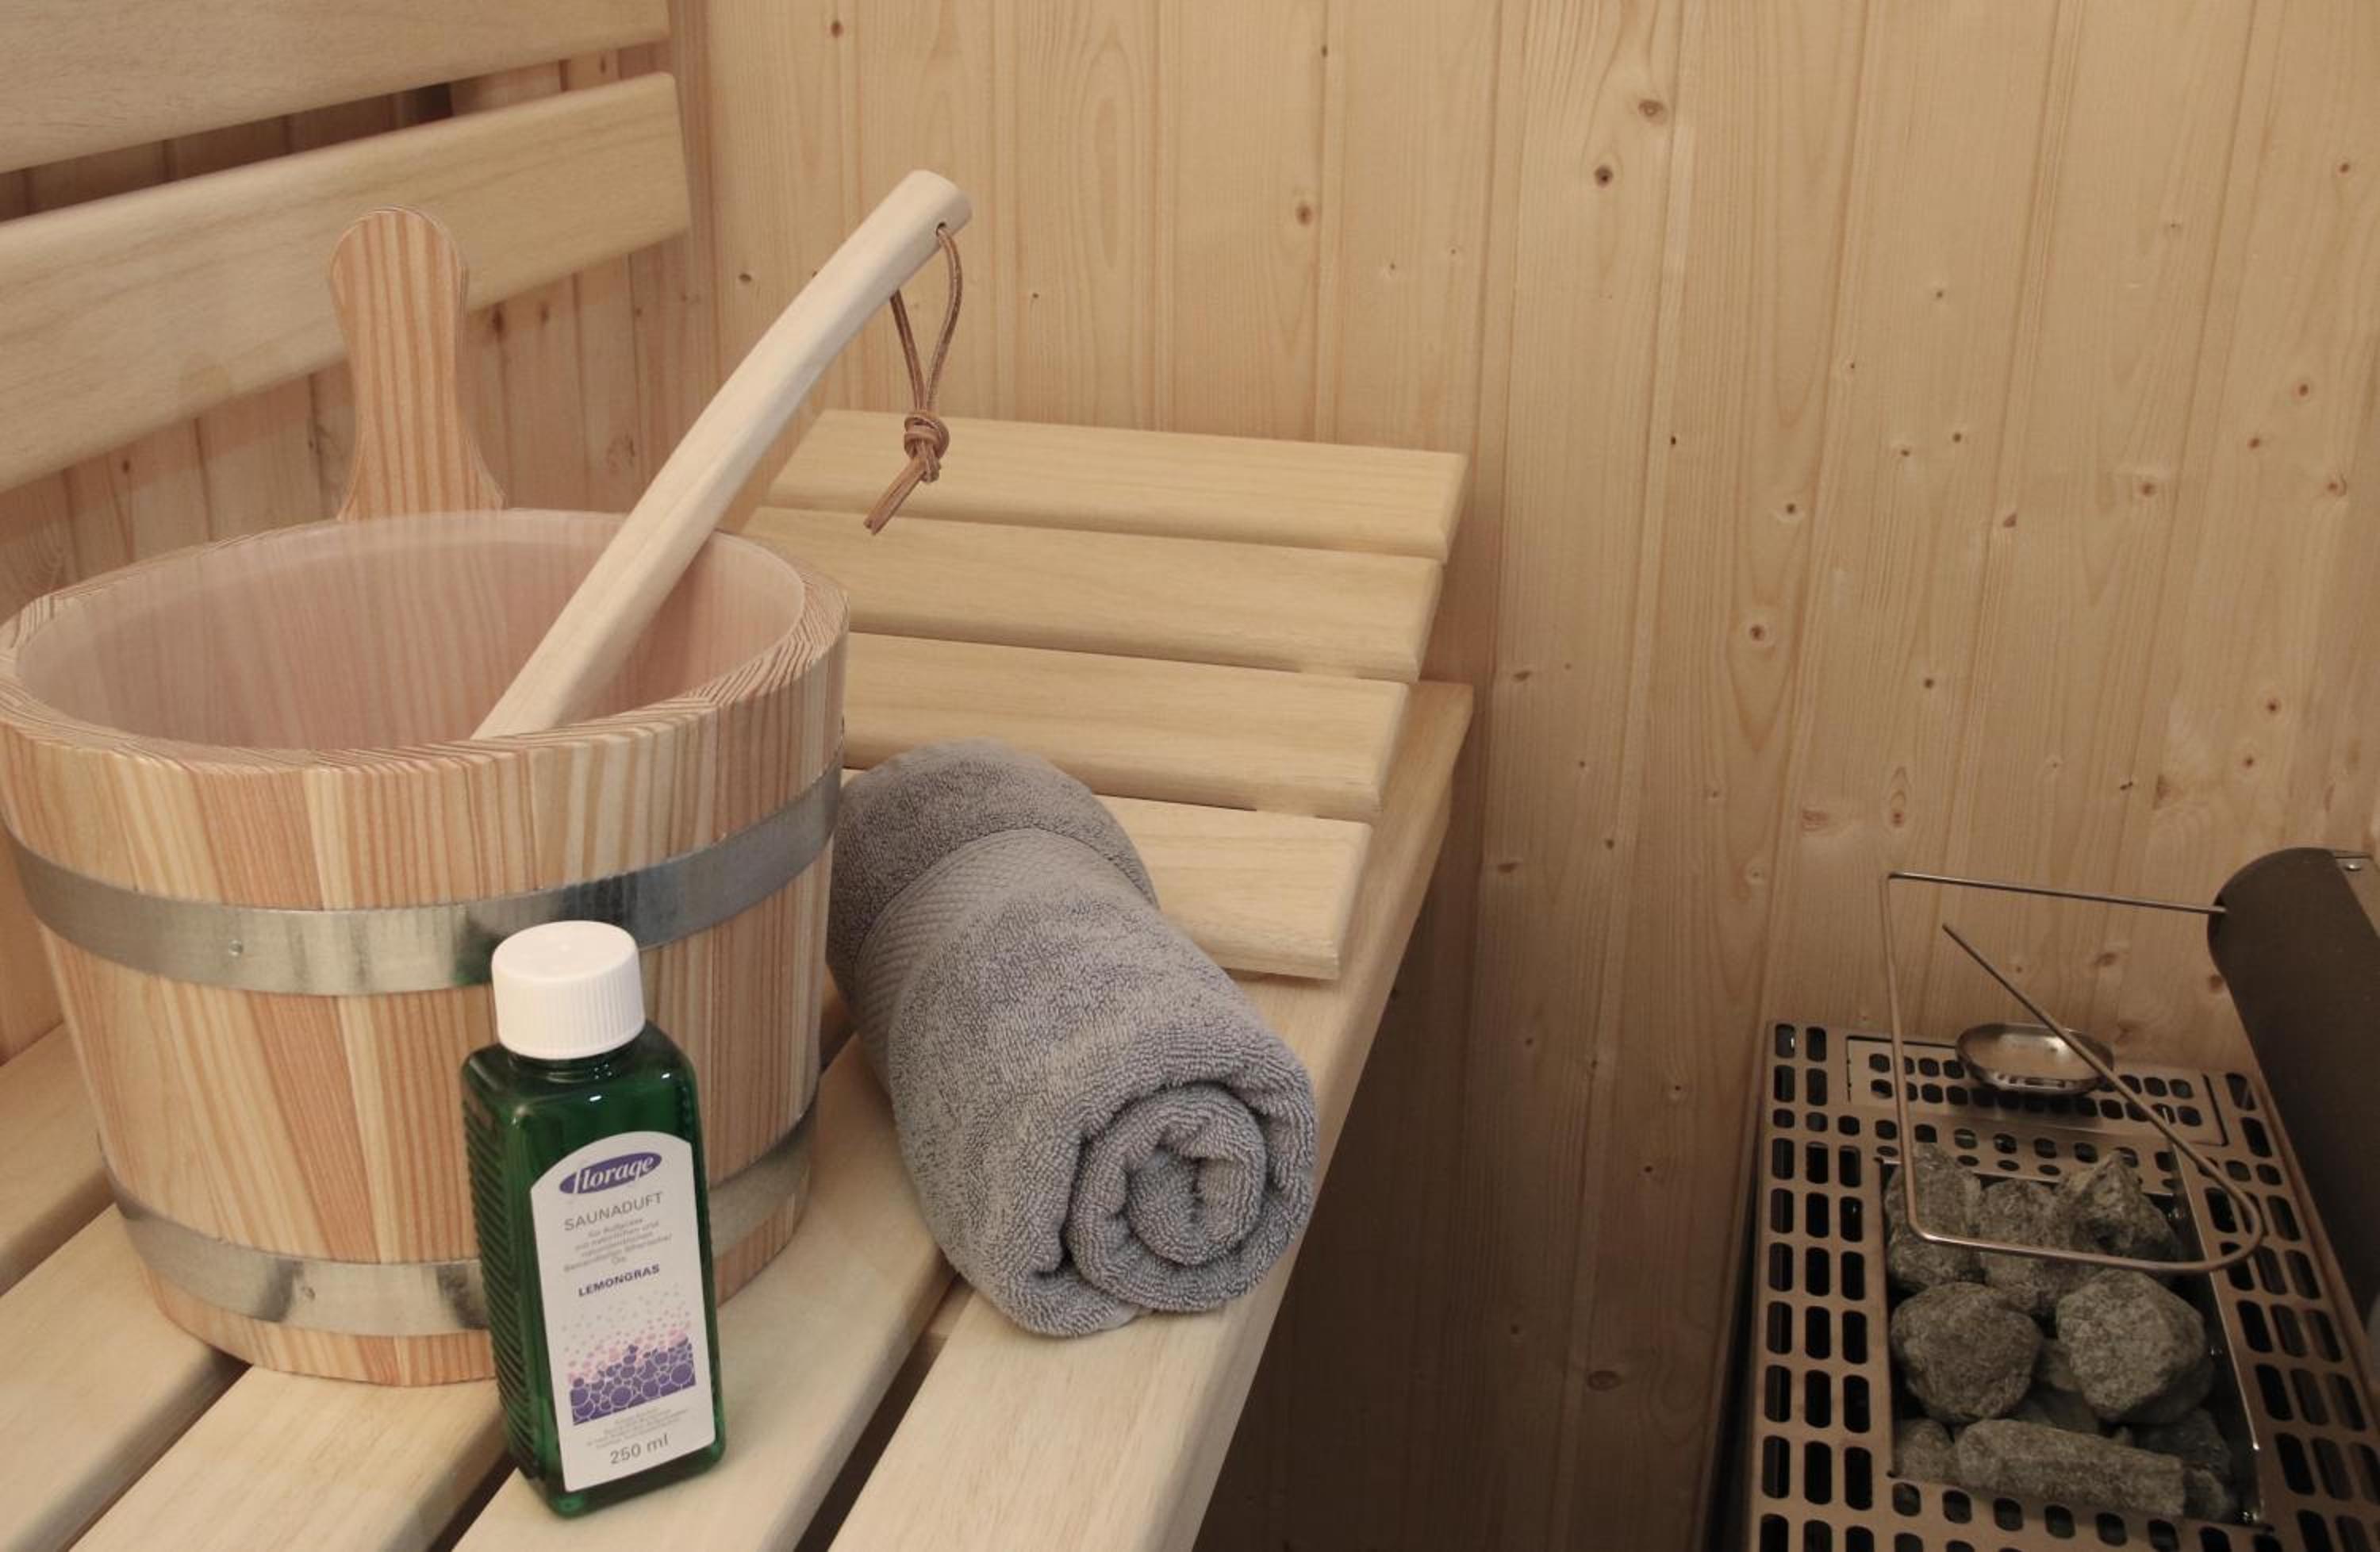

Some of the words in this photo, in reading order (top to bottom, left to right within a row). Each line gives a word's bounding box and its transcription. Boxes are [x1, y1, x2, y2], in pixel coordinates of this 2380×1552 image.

[564, 1192, 662, 1231] SAUNADUFT
[578, 1263, 660, 1297] LEMONGRAS
[610, 1443, 641, 1464] 250
[647, 1434, 668, 1453] ml
